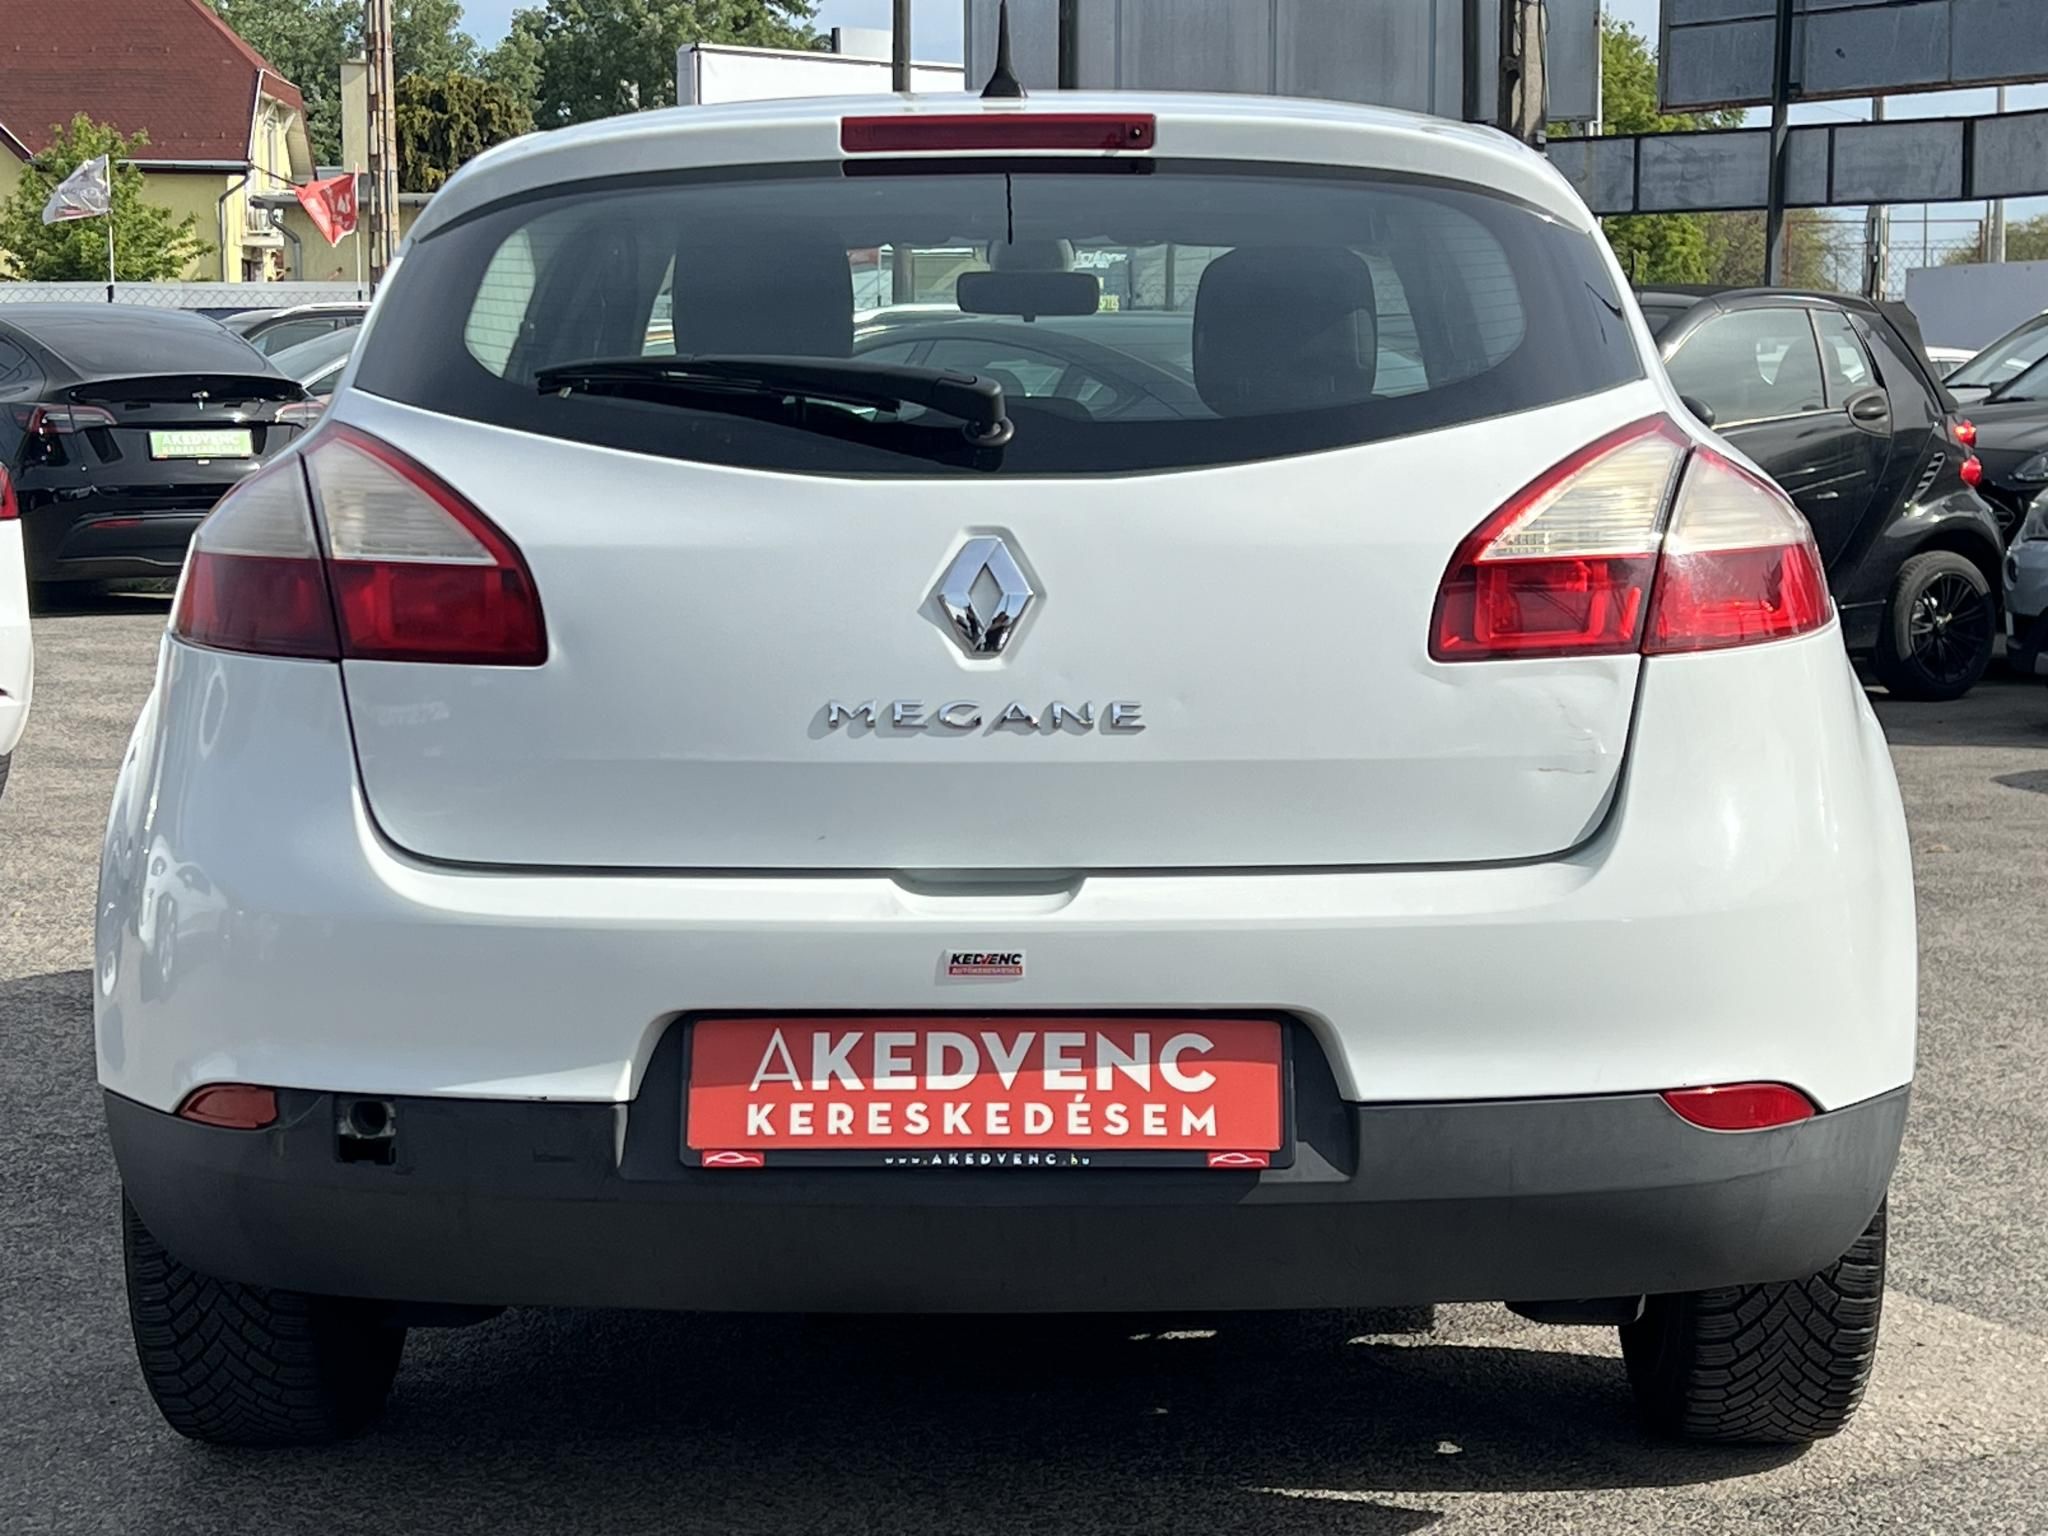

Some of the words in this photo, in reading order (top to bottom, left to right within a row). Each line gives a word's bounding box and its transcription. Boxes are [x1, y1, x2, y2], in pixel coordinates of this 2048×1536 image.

[828, 699, 1147, 730] MEGANE
[950, 953, 1023, 965] KEDVENC
[746, 1094, 1217, 1137] KERESKEDÉSEM
[884, 1153, 1090, 1166] www.AKEDVENC.hu
